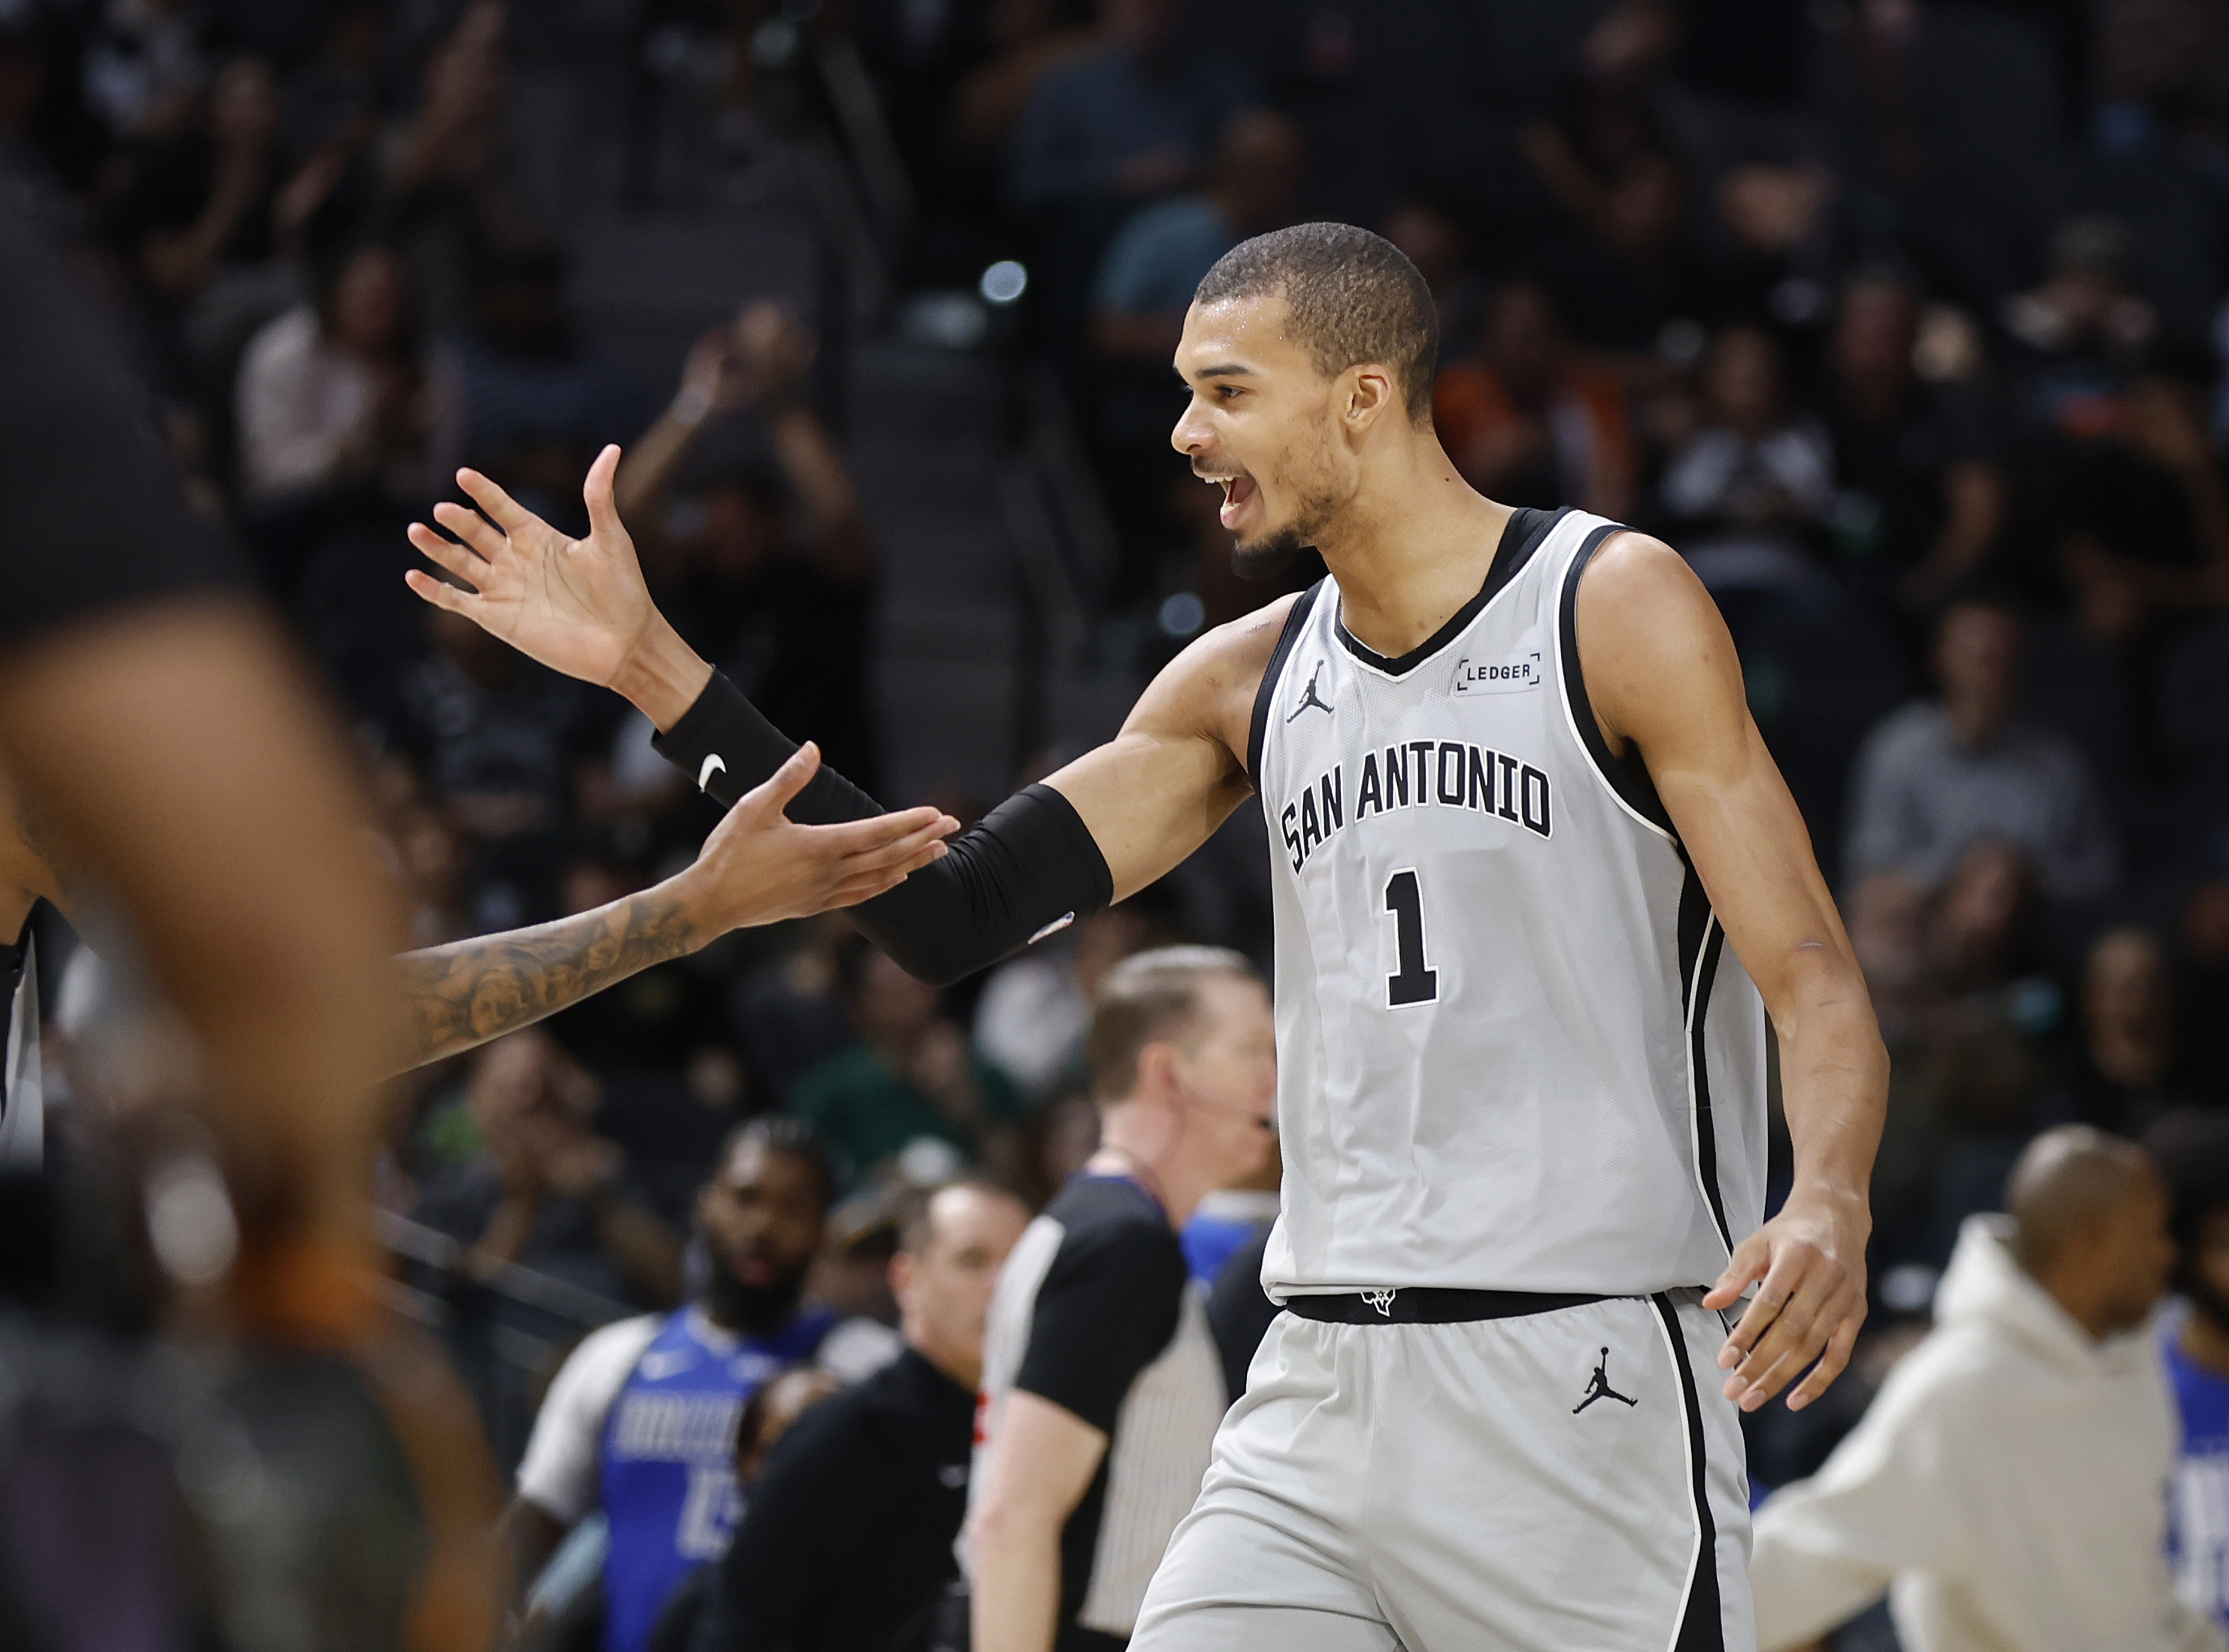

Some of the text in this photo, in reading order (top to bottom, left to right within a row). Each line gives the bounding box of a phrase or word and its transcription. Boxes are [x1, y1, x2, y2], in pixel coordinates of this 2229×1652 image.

[1467, 664, 1530, 681] LEDGER
[1280, 739, 1553, 879] SAN ANTONIO
[1383, 867, 1440, 1010] 1
